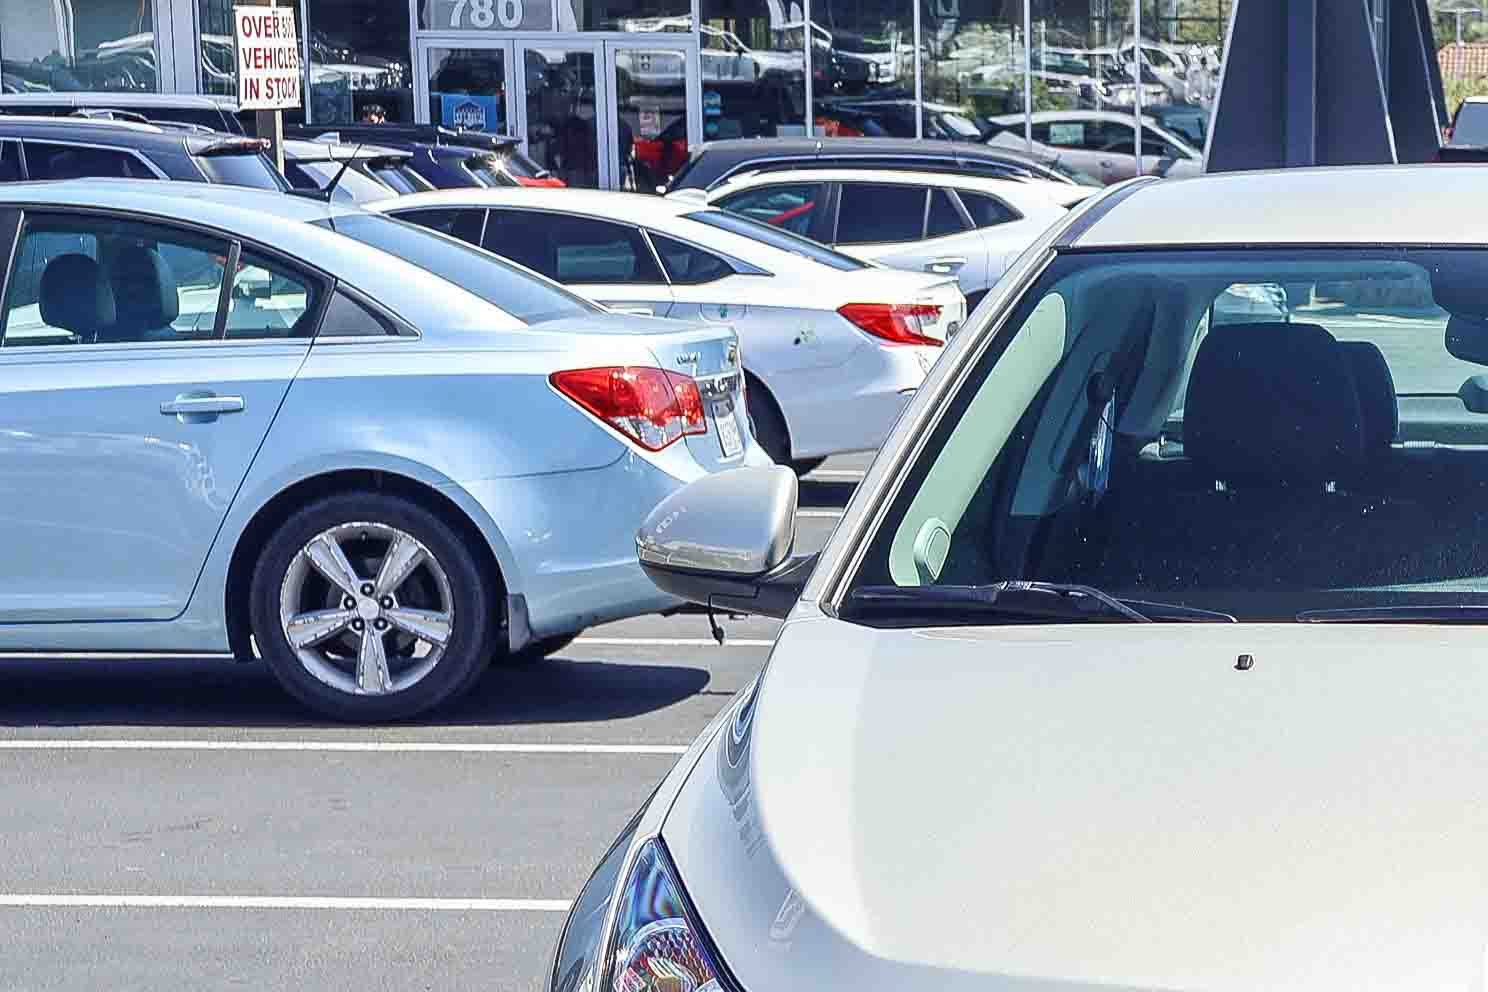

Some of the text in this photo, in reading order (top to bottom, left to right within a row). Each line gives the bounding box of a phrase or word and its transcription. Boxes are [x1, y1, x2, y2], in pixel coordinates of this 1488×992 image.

[449, 0, 523, 28] 780
[241, 15, 280, 38] OVER
[242, 47, 297, 70] VEHICLES
[244, 76, 297, 100] IN STOCK
